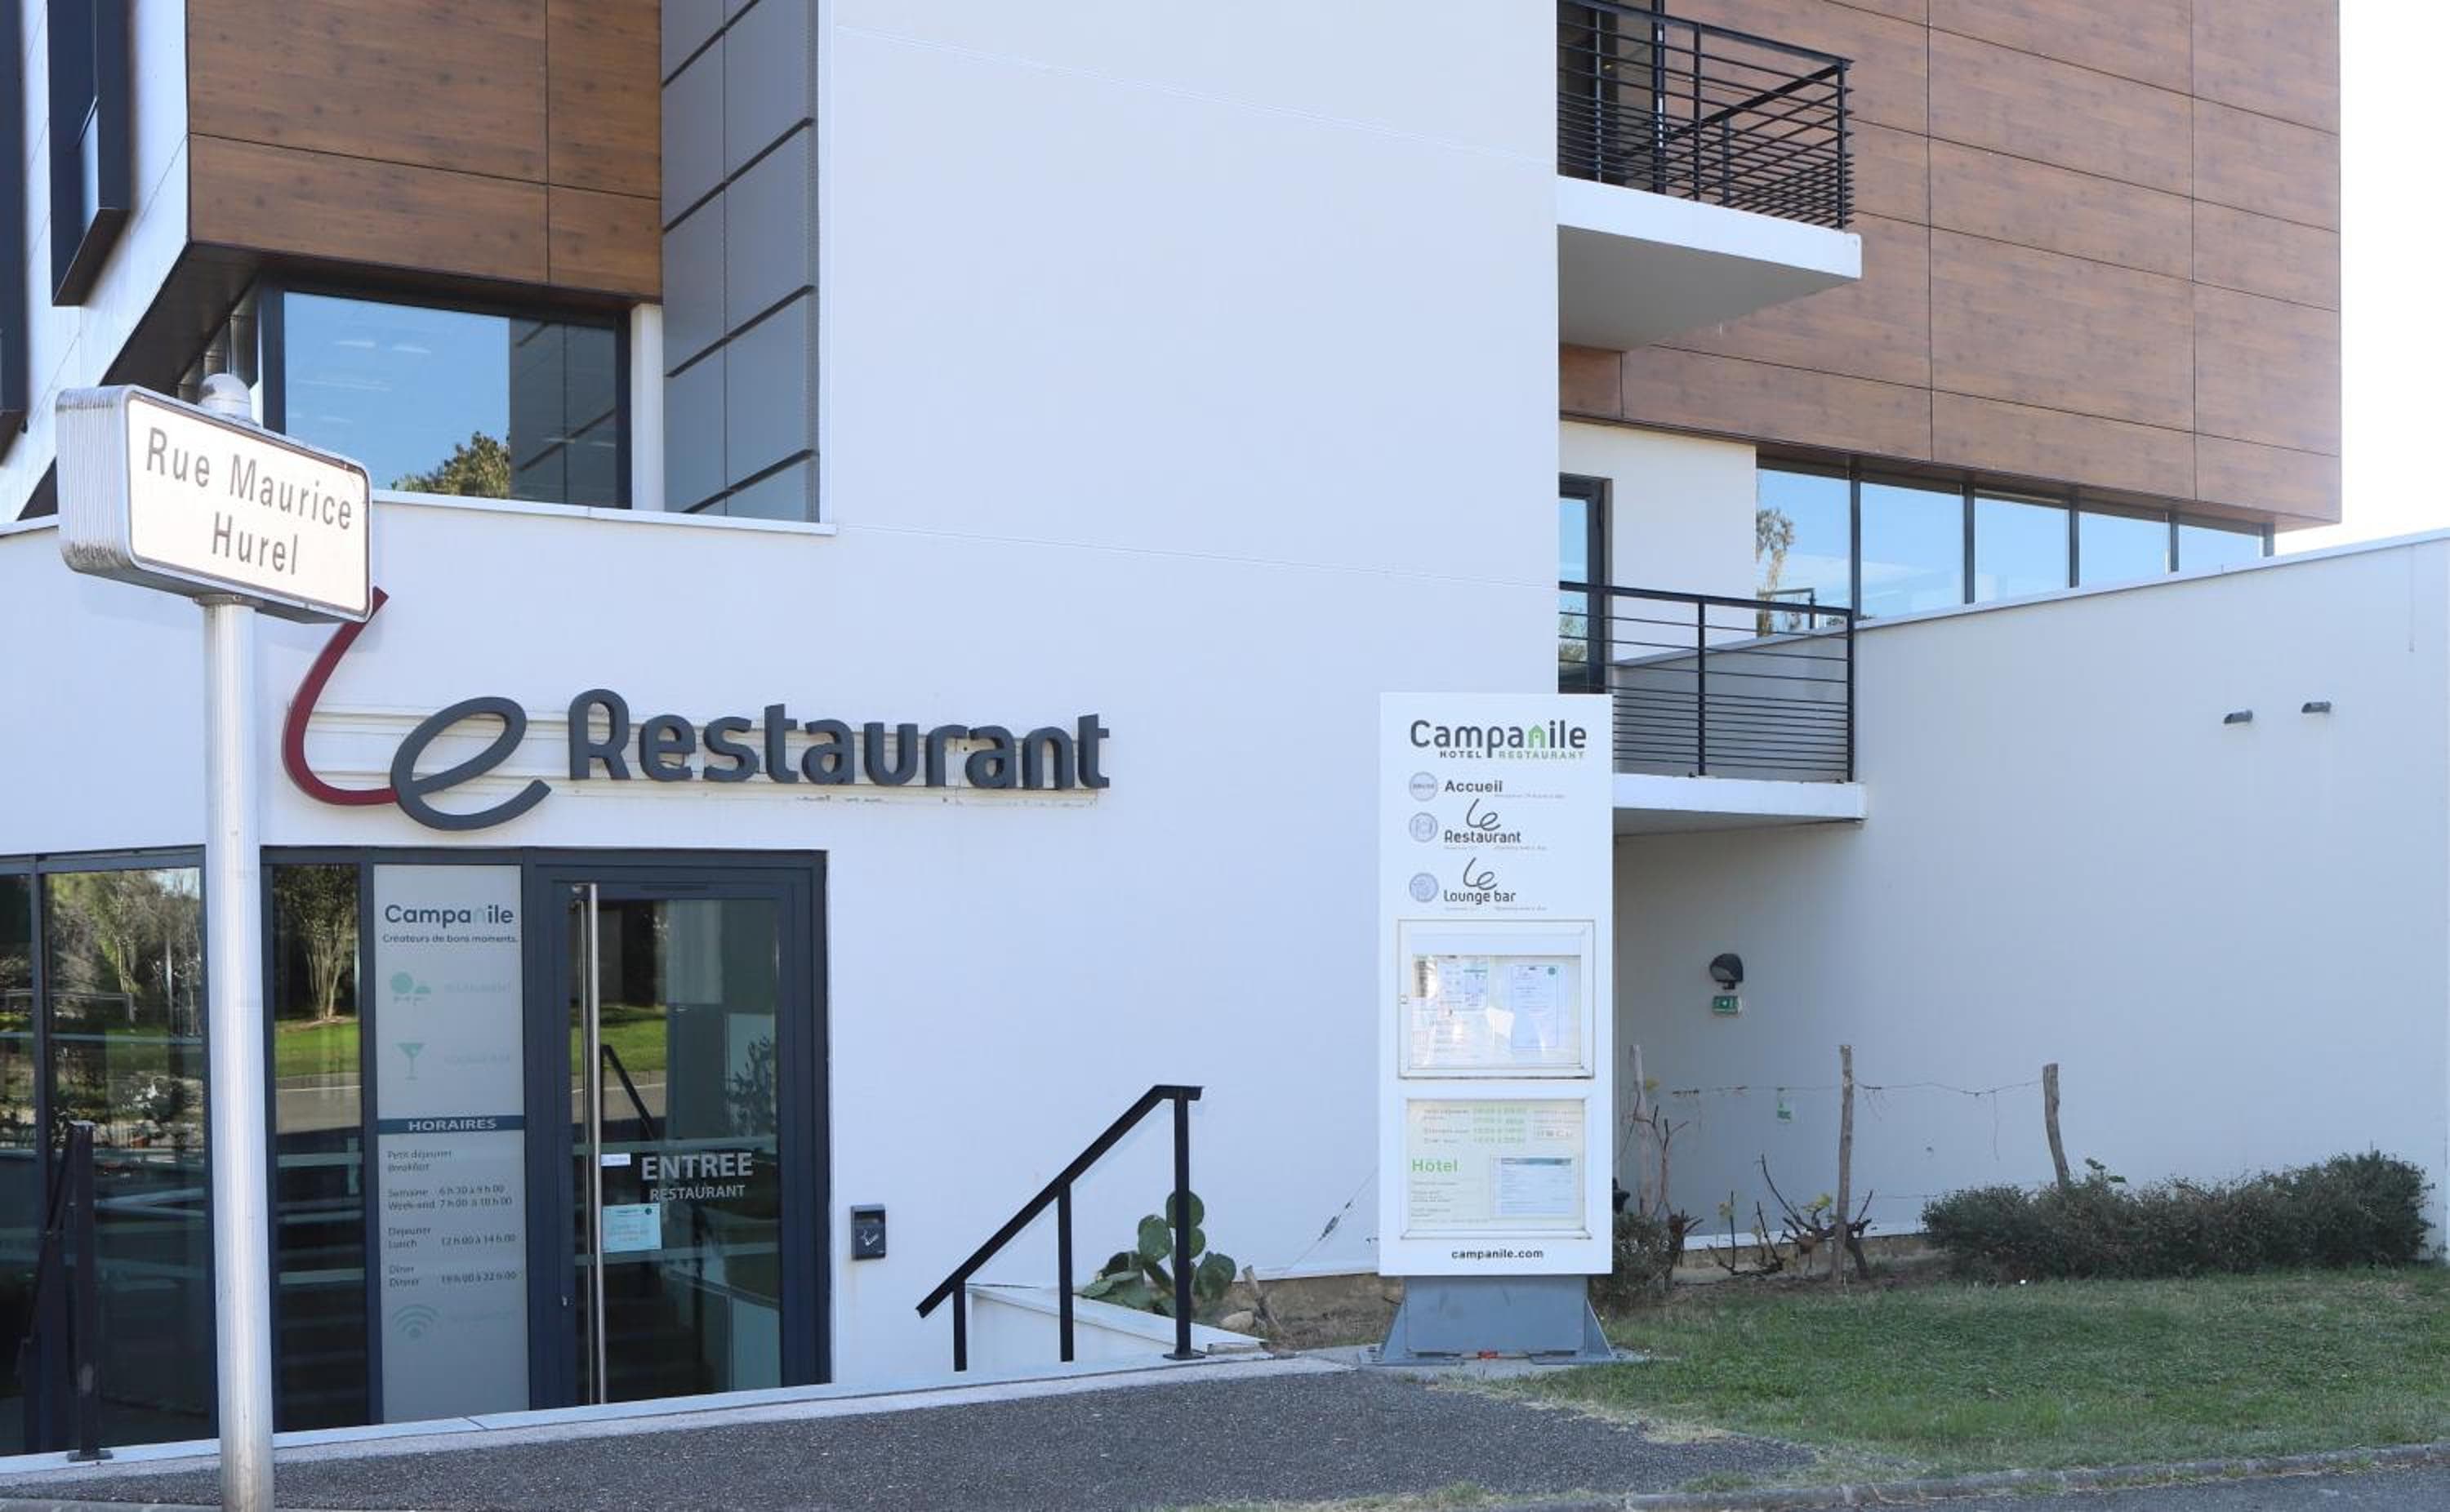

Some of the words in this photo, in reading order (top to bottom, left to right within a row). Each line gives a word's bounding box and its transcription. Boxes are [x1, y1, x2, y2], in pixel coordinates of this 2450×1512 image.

[146, 427, 210, 488] Rue
[229, 454, 353, 530] Maurice
[212, 512, 299, 575] Hurel
[568, 687, 1111, 790] Restaurant
[1410, 719, 1587, 758] Campanile
[1499, 750, 1585, 759] RESTAURANT
[1445, 780, 1503, 792] Accueil
[1444, 829, 1521, 843] Restaurant
[1443, 889, 1491, 905] Lounge
[1494, 889, 1517, 902] bar
[385, 904, 514, 928] Campanile
[432, 934, 444, 942] de
[408, 1118, 497, 1132] HORAIRES
[649, 1185, 746, 1202] RESTAURANT
[1451, 1247, 1544, 1260] campanile.com
